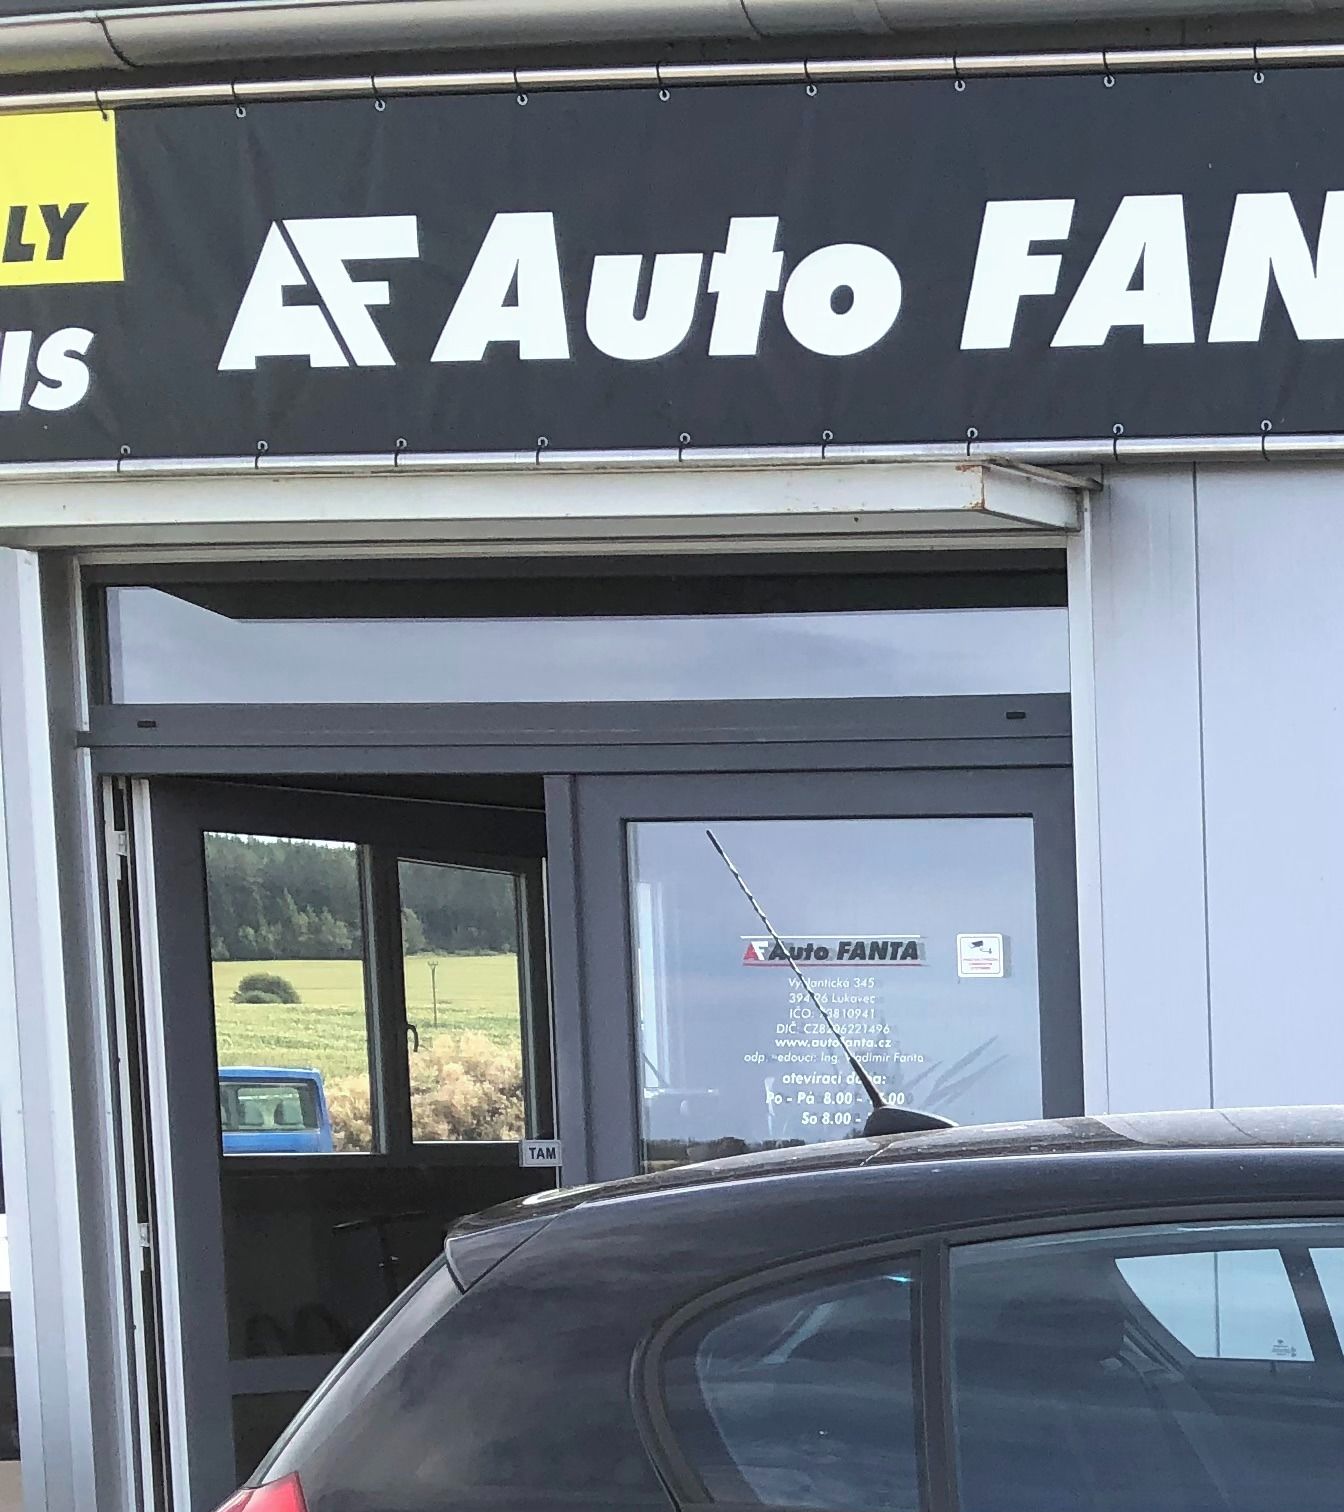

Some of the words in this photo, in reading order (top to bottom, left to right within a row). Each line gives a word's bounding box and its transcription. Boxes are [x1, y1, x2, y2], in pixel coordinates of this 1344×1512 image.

[430, 212, 901, 362] Auto
[769, 941, 829, 961] Auto
[837, 941, 918, 961] FANTA
[789, 977, 850, 989] Vylantická
[853, 977, 875, 988] 345
[832, 992, 876, 1003] Lukavec
[820, 1008, 875, 1018] 3810941
[775, 1037, 892, 1048] www.autoanta.cz
[893, 1052, 924, 1063] Fanta
[797, 1091, 815, 1105] Pá
[822, 1092, 853, 1105] 8.00
[801, 1112, 818, 1125] So
[821, 1112, 852, 1125] 8.00
[529, 1147, 556, 1160] TAM
